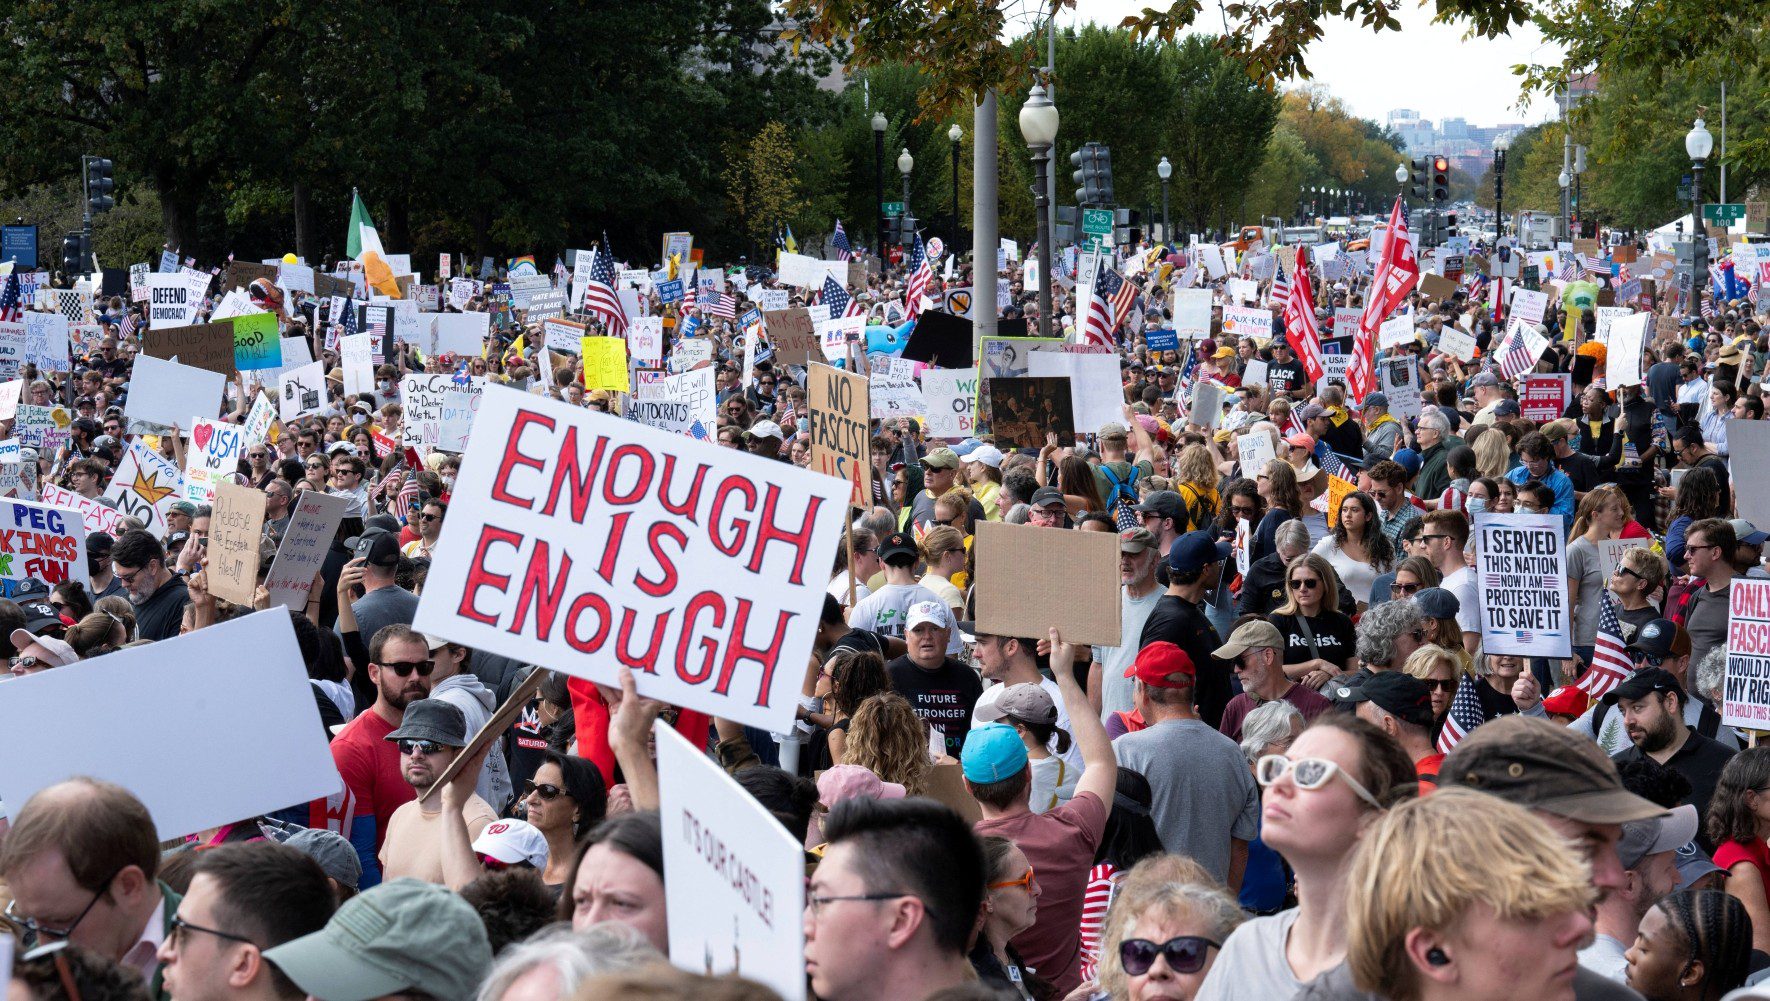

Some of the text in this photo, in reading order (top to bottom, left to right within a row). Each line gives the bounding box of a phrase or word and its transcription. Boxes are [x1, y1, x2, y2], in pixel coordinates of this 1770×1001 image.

[1716, 207, 1723, 217] 4
[1716, 219, 1731, 227] 100
[152, 287, 187, 304] DEFEND
[410, 284, 429, 293] FREE
[531, 290, 564, 302] HATE WILL
[410, 292, 426, 303] DC
[152, 307, 187, 320] DEMOCRACY
[529, 301, 562, 312] NOT MAKE
[1601, 309, 1612, 317] NO
[527, 312, 560, 322] US GREAT!
[1225, 313, 1272, 327] FAUX-KING
[1336, 313, 1362, 325] IMPEA
[209, 323, 229, 340] NO
[0, 347, 16, 356] UILD
[1329, 356, 1347, 364] USA:
[1270, 369, 1295, 380] BLACK
[1328, 366, 1346, 374] KING
[407, 379, 427, 393] Our
[638, 372, 655, 385] NO
[666, 372, 707, 395] WE will
[1327, 376, 1346, 384] FREE
[640, 385, 665, 399] KINGS
[827, 373, 852, 416] NO
[927, 377, 954, 397] GO
[408, 396, 420, 404] The
[887, 400, 900, 409] IS
[407, 406, 437, 421] We the
[632, 401, 689, 422] AUTOCRATS
[245, 403, 263, 437] ABOLISH
[927, 413, 954, 432] GO
[253, 420, 264, 436] ICE
[404, 423, 440, 445] Say N
[811, 409, 867, 462] FASCIST
[209, 427, 239, 459] USA
[143, 450, 175, 482] 1776
[205, 456, 221, 469] NO
[491, 408, 827, 587] ENOUGH
[117, 490, 153, 530] NO
[13, 503, 66, 536] PEG
[0, 529, 78, 562] KINGS
[1482, 529, 1557, 555] I SERVED
[594, 510, 690, 598] IS
[25, 557, 69, 585] FUN
[1484, 555, 1559, 575] THIS NATION
[1500, 574, 1543, 588] NOW I AM
[1486, 588, 1560, 608] PROTESTING
[456, 523, 801, 709] ENOUGH
[1487, 607, 1561, 630] TO SAVE IT
[877, 624, 894, 635] MAY
[1289, 633, 1342, 647] Reist.
[1729, 656, 1762, 678] WOULD
[1726, 676, 1770, 705] MY RIG
[918, 694, 958, 704] FUTURE
[1725, 702, 1767, 721] TO HOLD THIS
[934, 723, 946, 733] IN
[682, 807, 775, 932] IT'S OUR CASTLE!
